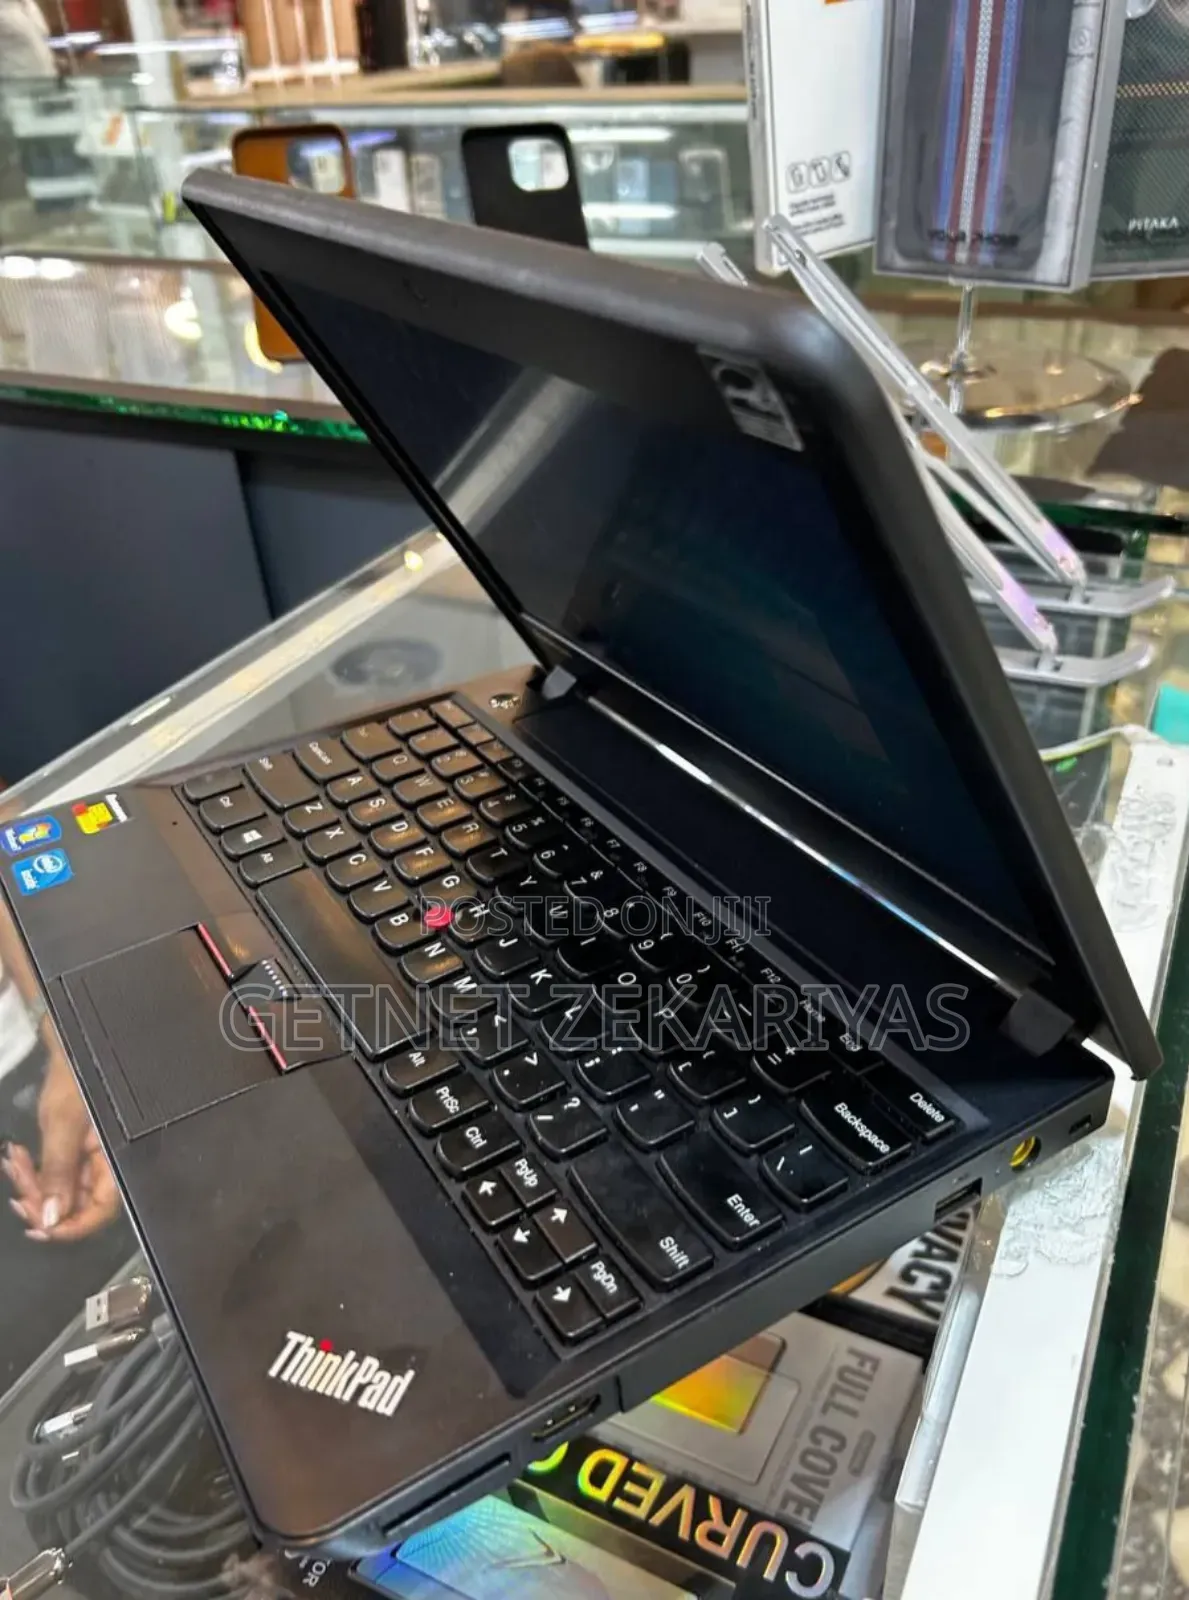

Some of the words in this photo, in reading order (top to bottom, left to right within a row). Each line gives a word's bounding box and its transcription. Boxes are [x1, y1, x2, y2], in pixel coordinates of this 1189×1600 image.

[347, 776, 363, 786] A
[305, 803, 323, 813] Z
[369, 797, 386, 809] S
[437, 798, 454, 809] E
[325, 827, 345, 839] X
[392, 821, 408, 832] D
[462, 822, 480, 834] R
[606, 838, 621, 849] F7
[415, 847, 434, 857] F
[490, 848, 508, 859] T
[540, 849, 556, 860] 6
[350, 853, 367, 866] C
[373, 880, 392, 893] V
[442, 875, 460, 889] G
[519, 875, 538, 887] Y
[570, 876, 588, 886] 7
[469, 903, 490, 918] H
[549, 904, 568, 919] U
[603, 907, 619, 918] 8
[390, 913, 409, 927] B
[693, 911, 712, 928] F10
[424, 941, 446, 957] N
[499, 937, 518, 948] J
[638, 939, 655, 951] 9
[726, 938, 744, 954] F11
[530, 968, 553, 985] K
[617, 972, 637, 986] O
[760, 967, 781, 983] F12
[453, 975, 478, 993] M
[564, 1005, 582, 1021] L
[653, 1007, 675, 1020] P
[408, 1051, 426, 1068] Alt
[435, 1085, 460, 1114] PrtSc
[563, 1097, 581, 1110] ?
[909, 1092, 945, 1123] Delete
[834, 1102, 890, 1154] Backspace
[465, 1126, 487, 1149] Ctrl
[514, 1157, 539, 1188] PgUp
[727, 1194, 760, 1228] Enter
[659, 1236, 691, 1269] Shift
[590, 1260, 619, 1294] PgDn
[267, 1331, 416, 1417] ThinkPad
[820, 1347, 882, 1418] FULL
[776, 1425, 847, 1532] COVE
[577, 1448, 834, 1599] CURVED
